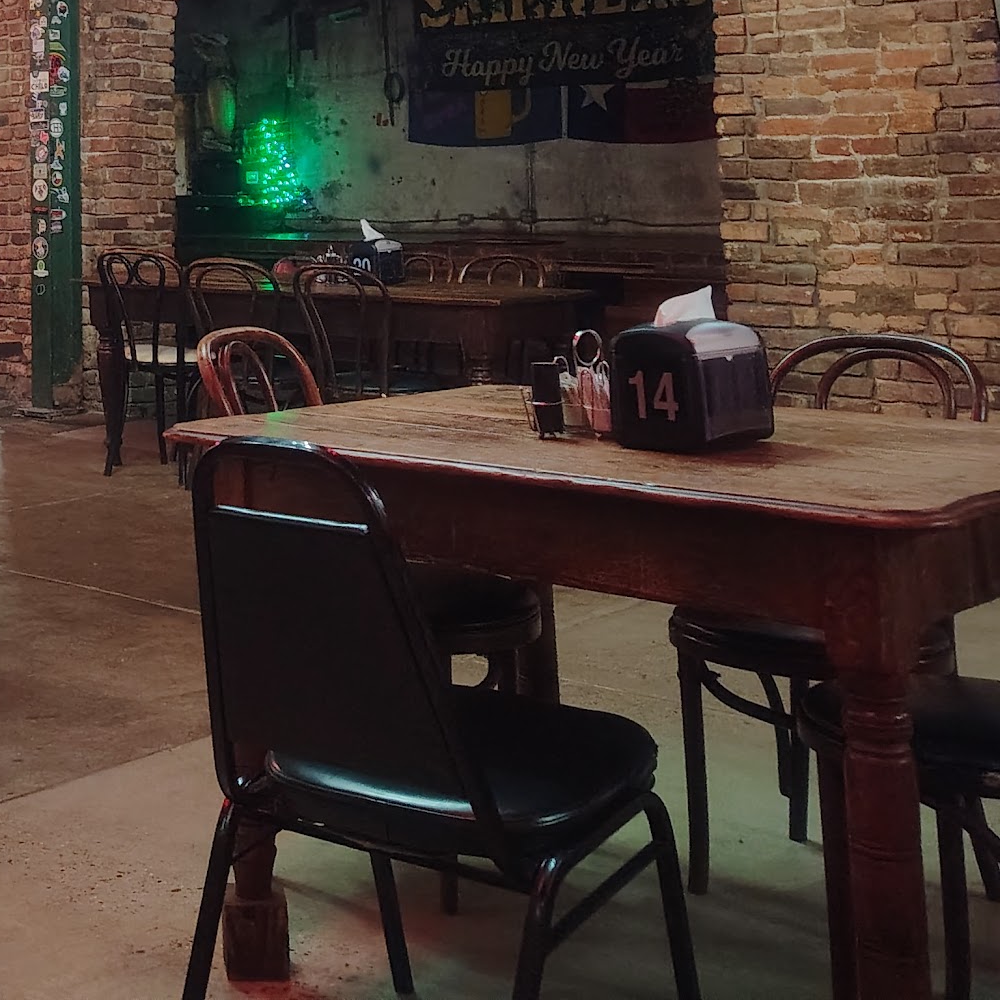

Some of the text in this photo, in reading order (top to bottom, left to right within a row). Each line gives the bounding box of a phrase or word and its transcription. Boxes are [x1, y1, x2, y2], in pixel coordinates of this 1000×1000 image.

[442, 36, 684, 87] Happy New Year
[628, 369, 680, 423] 14
